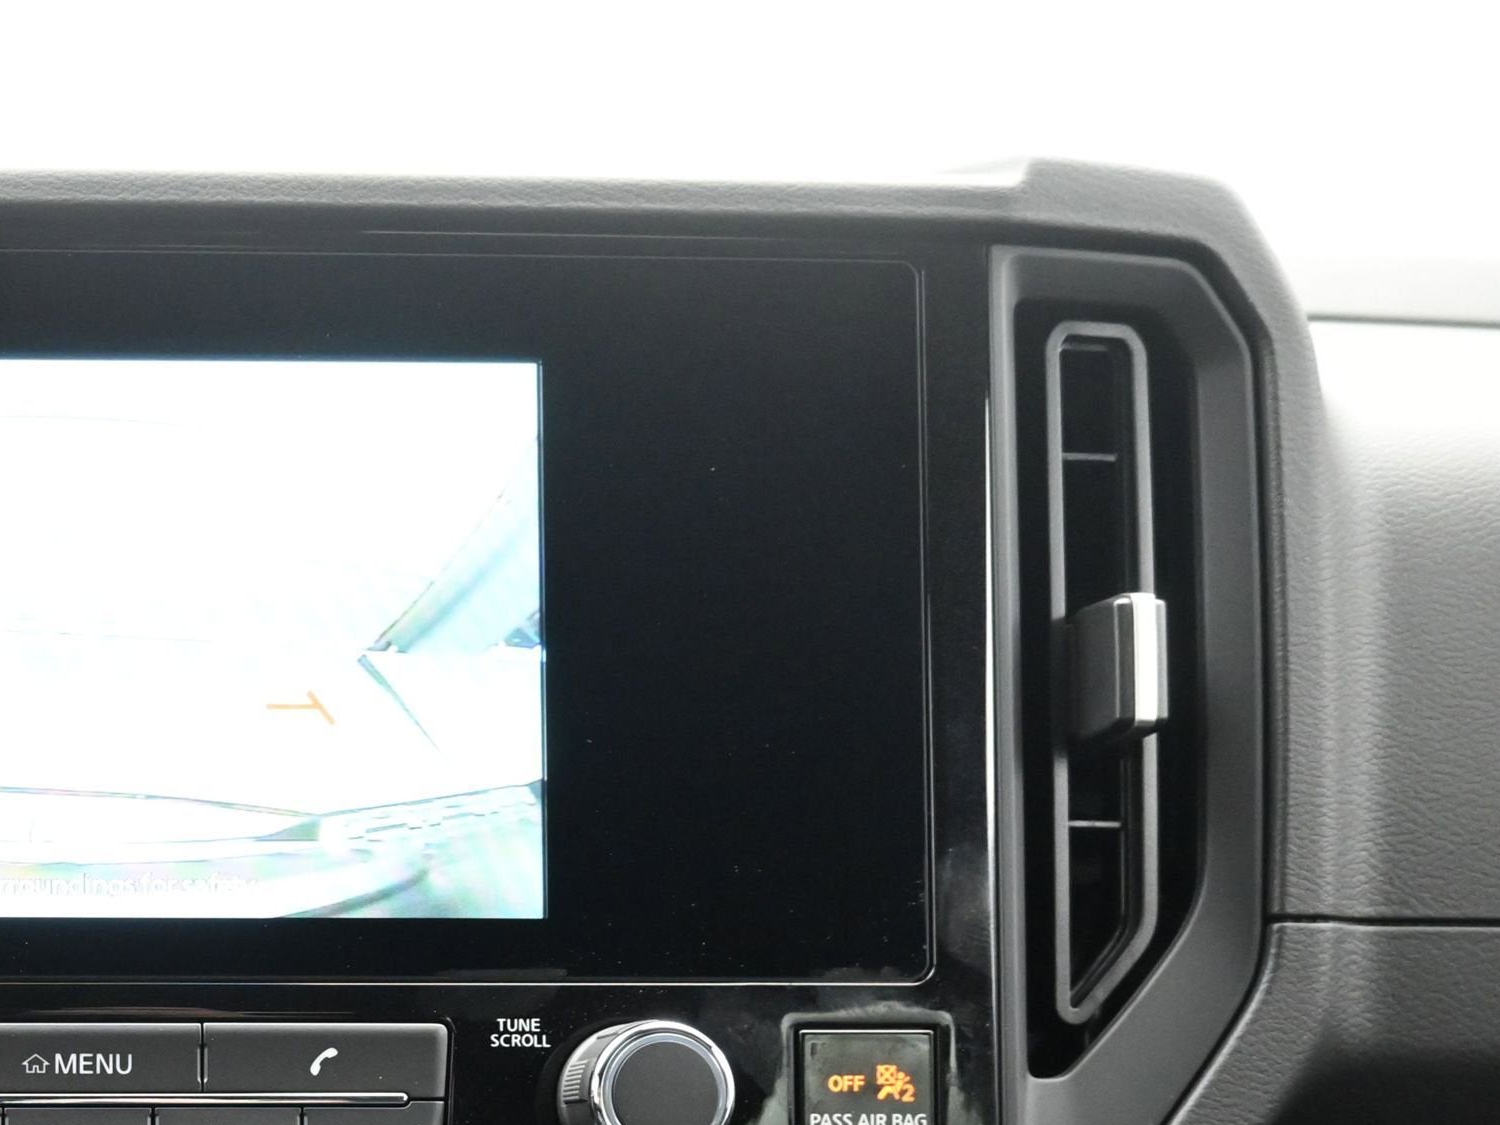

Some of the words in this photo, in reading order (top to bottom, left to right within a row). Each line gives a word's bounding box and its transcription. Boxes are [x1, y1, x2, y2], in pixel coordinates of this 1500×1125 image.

[496, 1018, 541, 1032] TUNE
[490, 1033, 552, 1048] SCROLL
[55, 1054, 133, 1075] MENU
[828, 1074, 866, 1093] OFF
